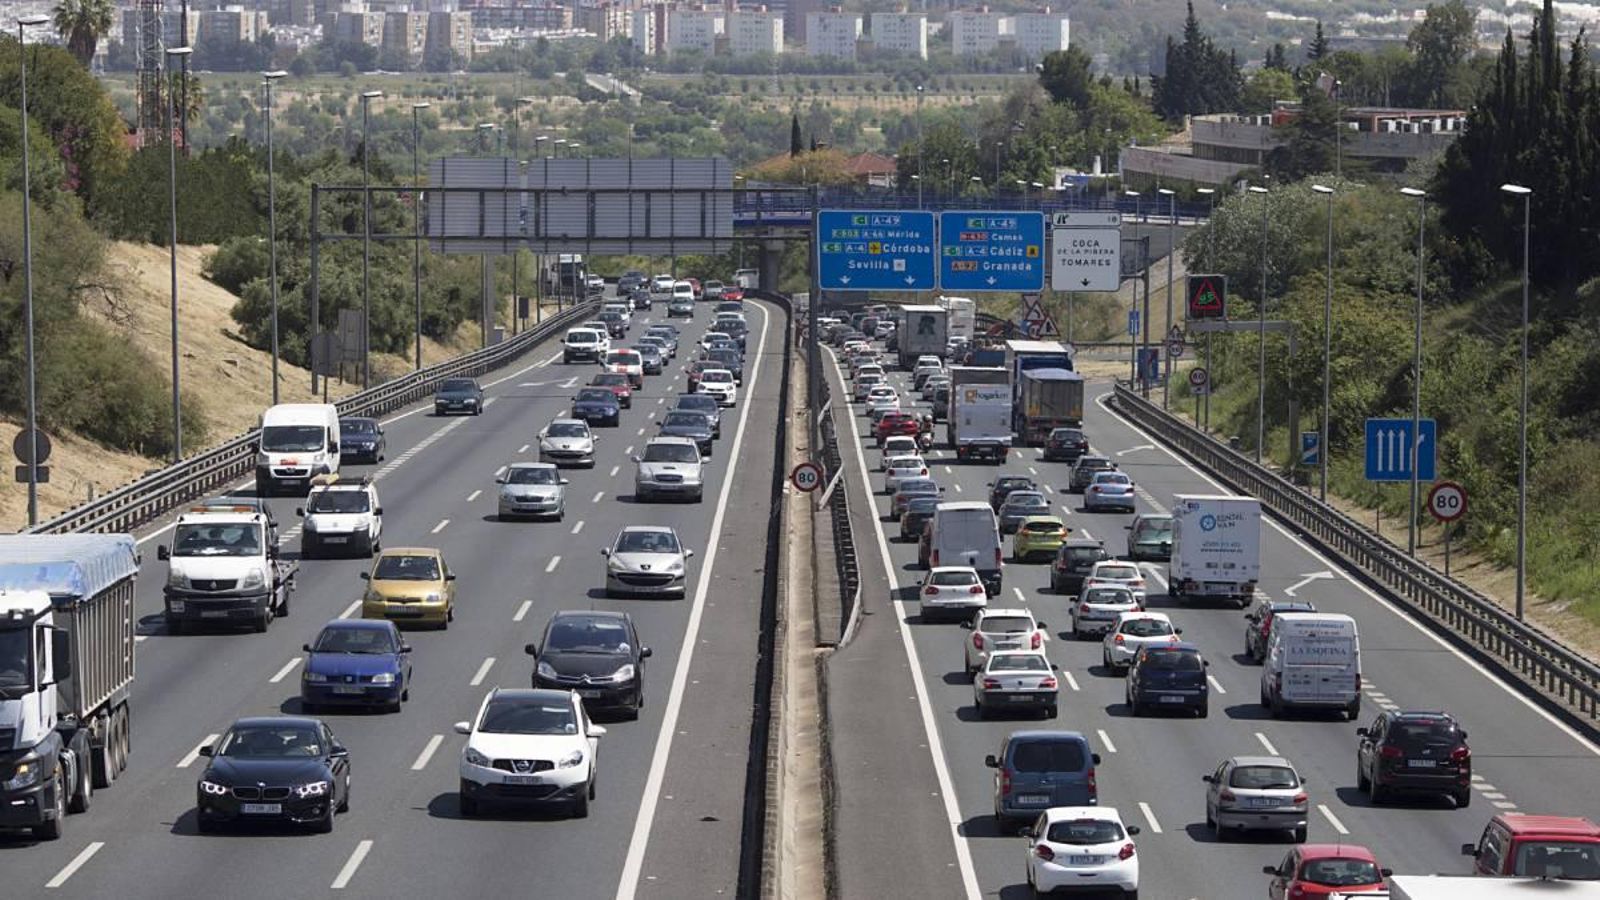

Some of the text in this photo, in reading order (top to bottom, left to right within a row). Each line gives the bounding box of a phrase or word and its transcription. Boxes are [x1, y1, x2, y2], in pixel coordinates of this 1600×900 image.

[874, 216, 899, 225] A-49
[887, 230, 920, 238] Mérida
[883, 242, 930, 253] Córdoba
[990, 246, 1023, 256] Cádiz
[848, 260, 889, 269] Sevilla
[983, 262, 1031, 270] Granada
[800, 472, 815, 482] 80
[1437, 495, 1458, 508] 80
[1291, 646, 1347, 657] LA ESQUINA
